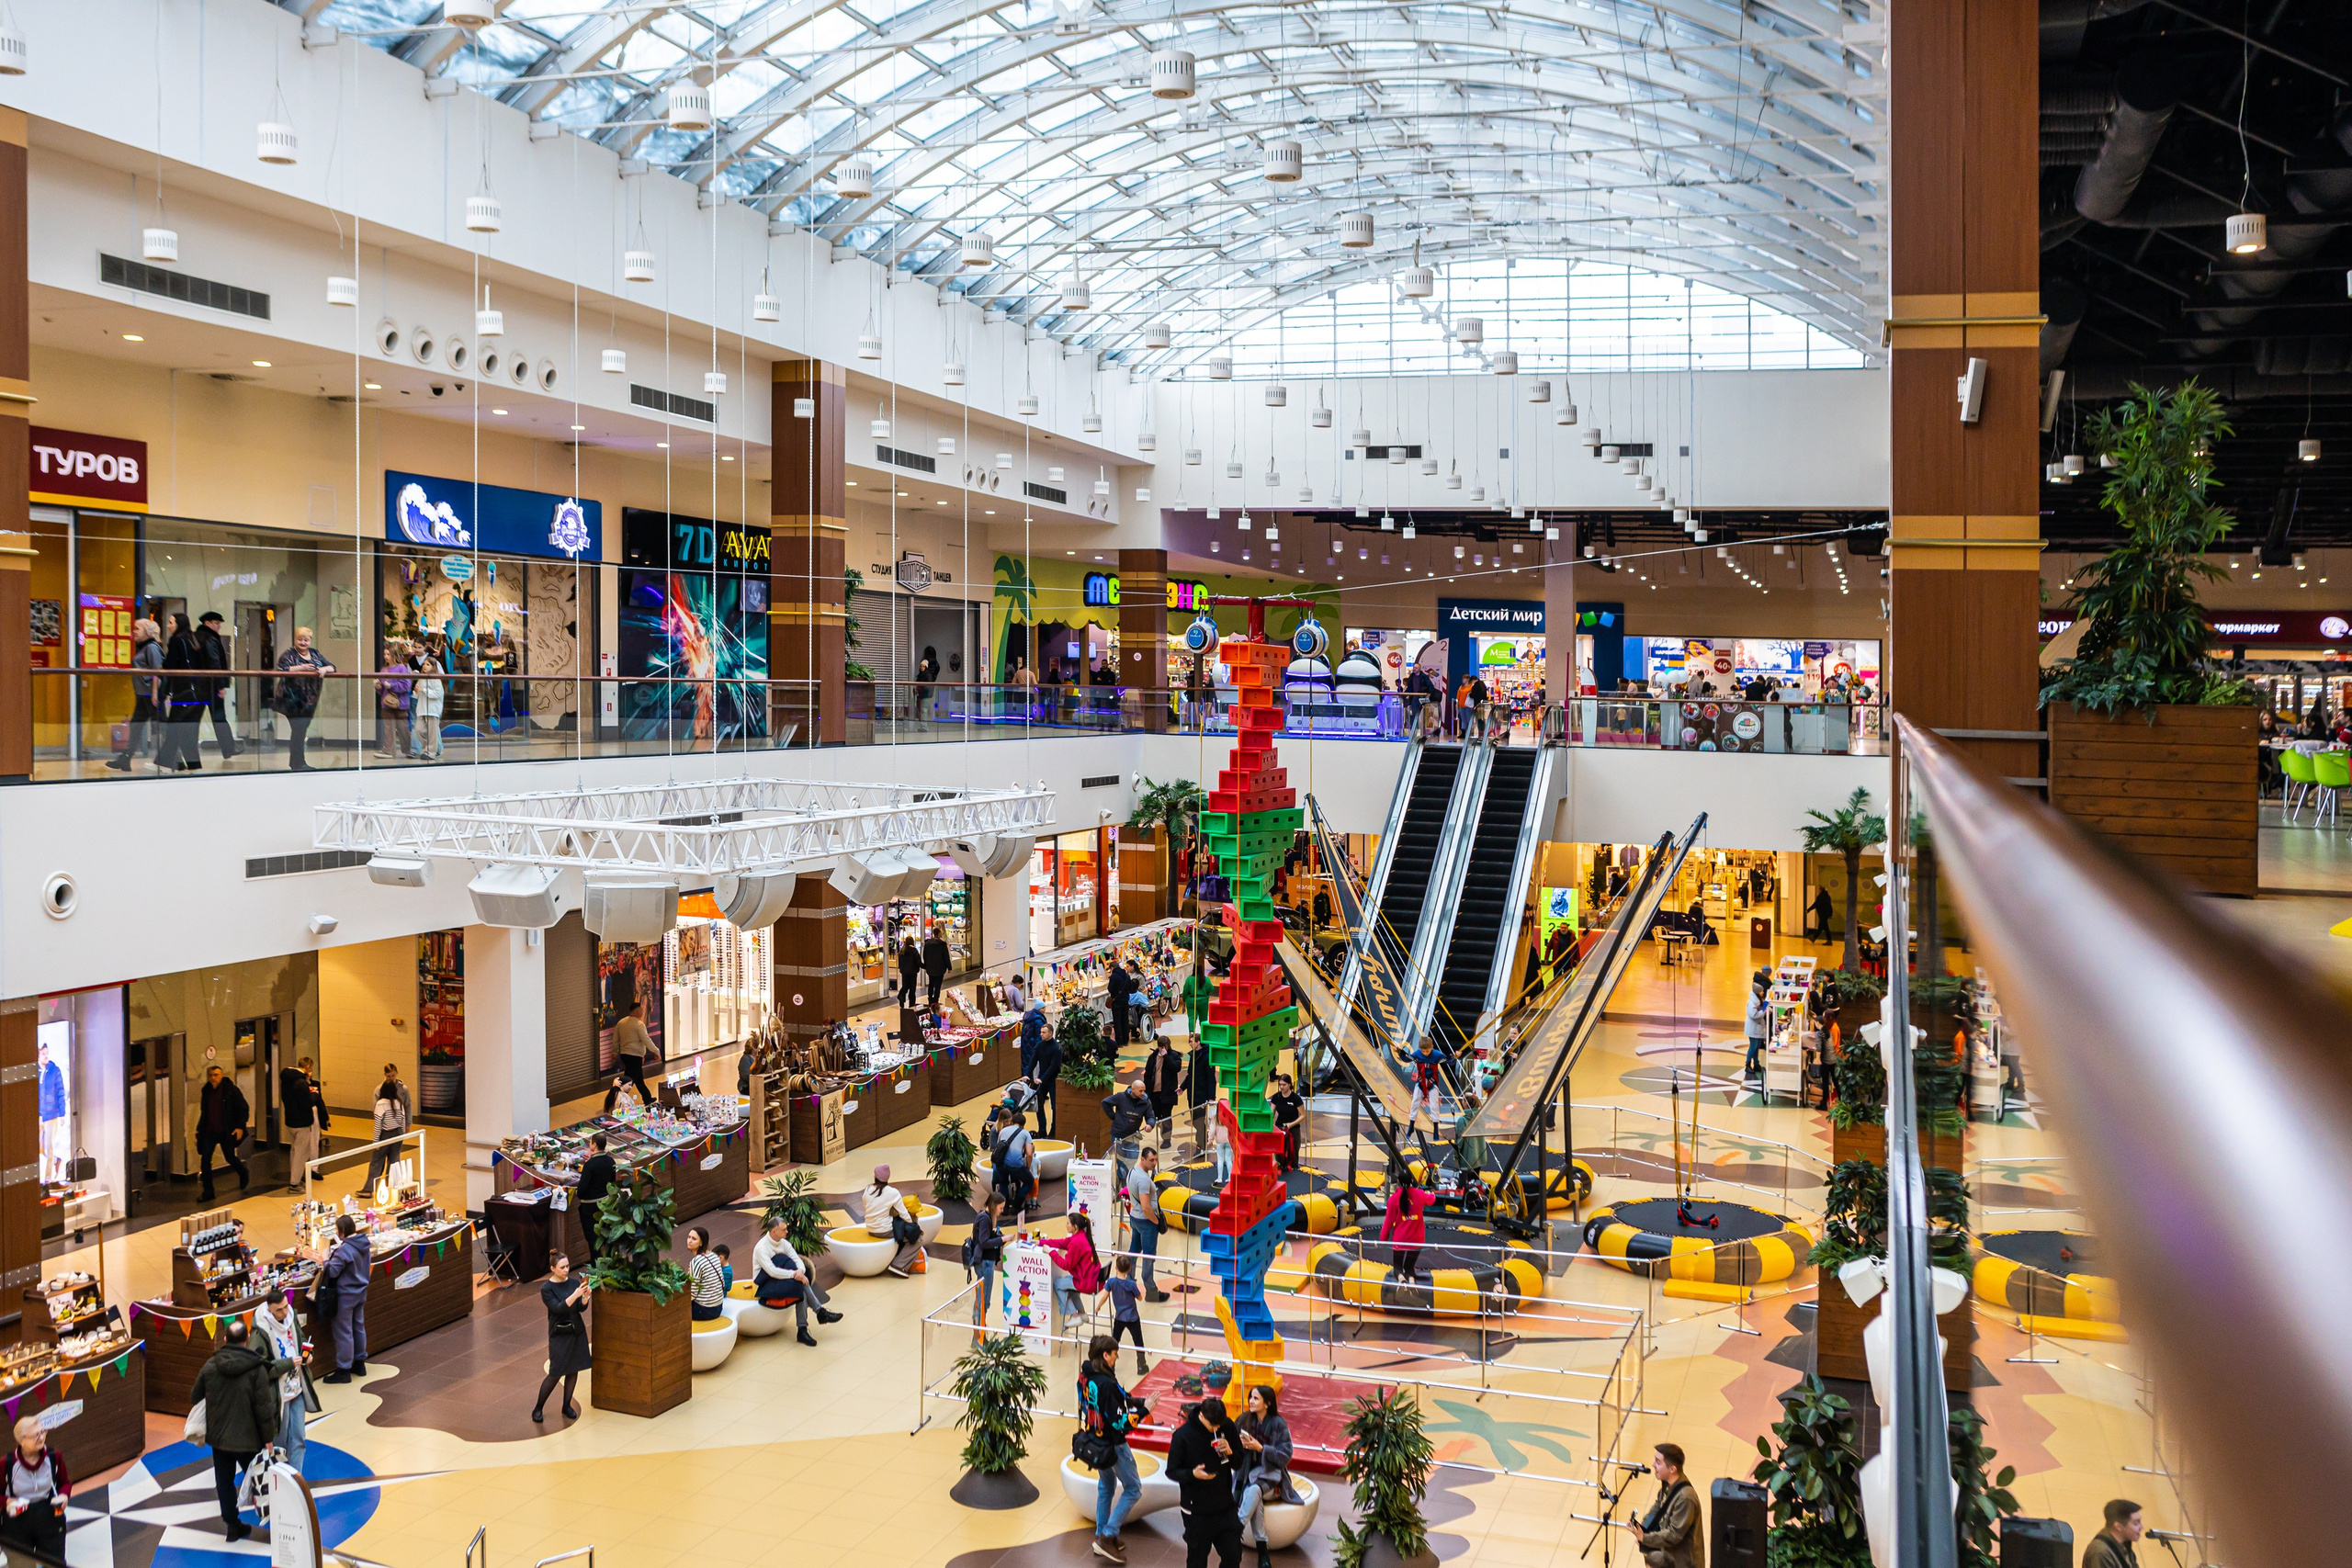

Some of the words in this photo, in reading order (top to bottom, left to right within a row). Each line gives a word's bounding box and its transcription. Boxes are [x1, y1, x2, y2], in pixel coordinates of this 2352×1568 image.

[33, 446, 140, 484] ТУРОВ
[871, 563, 892, 576] СТУДИЯ
[933, 570, 952, 583] ТАНЦЕВ
[1450, 605, 1509, 621] Детский
[1512, 610, 1544, 626] мир
[1440, 640, 1448, 651] 2
[1021, 1256, 1044, 1267] WALL
[1017, 1265, 1048, 1276] ACTION
